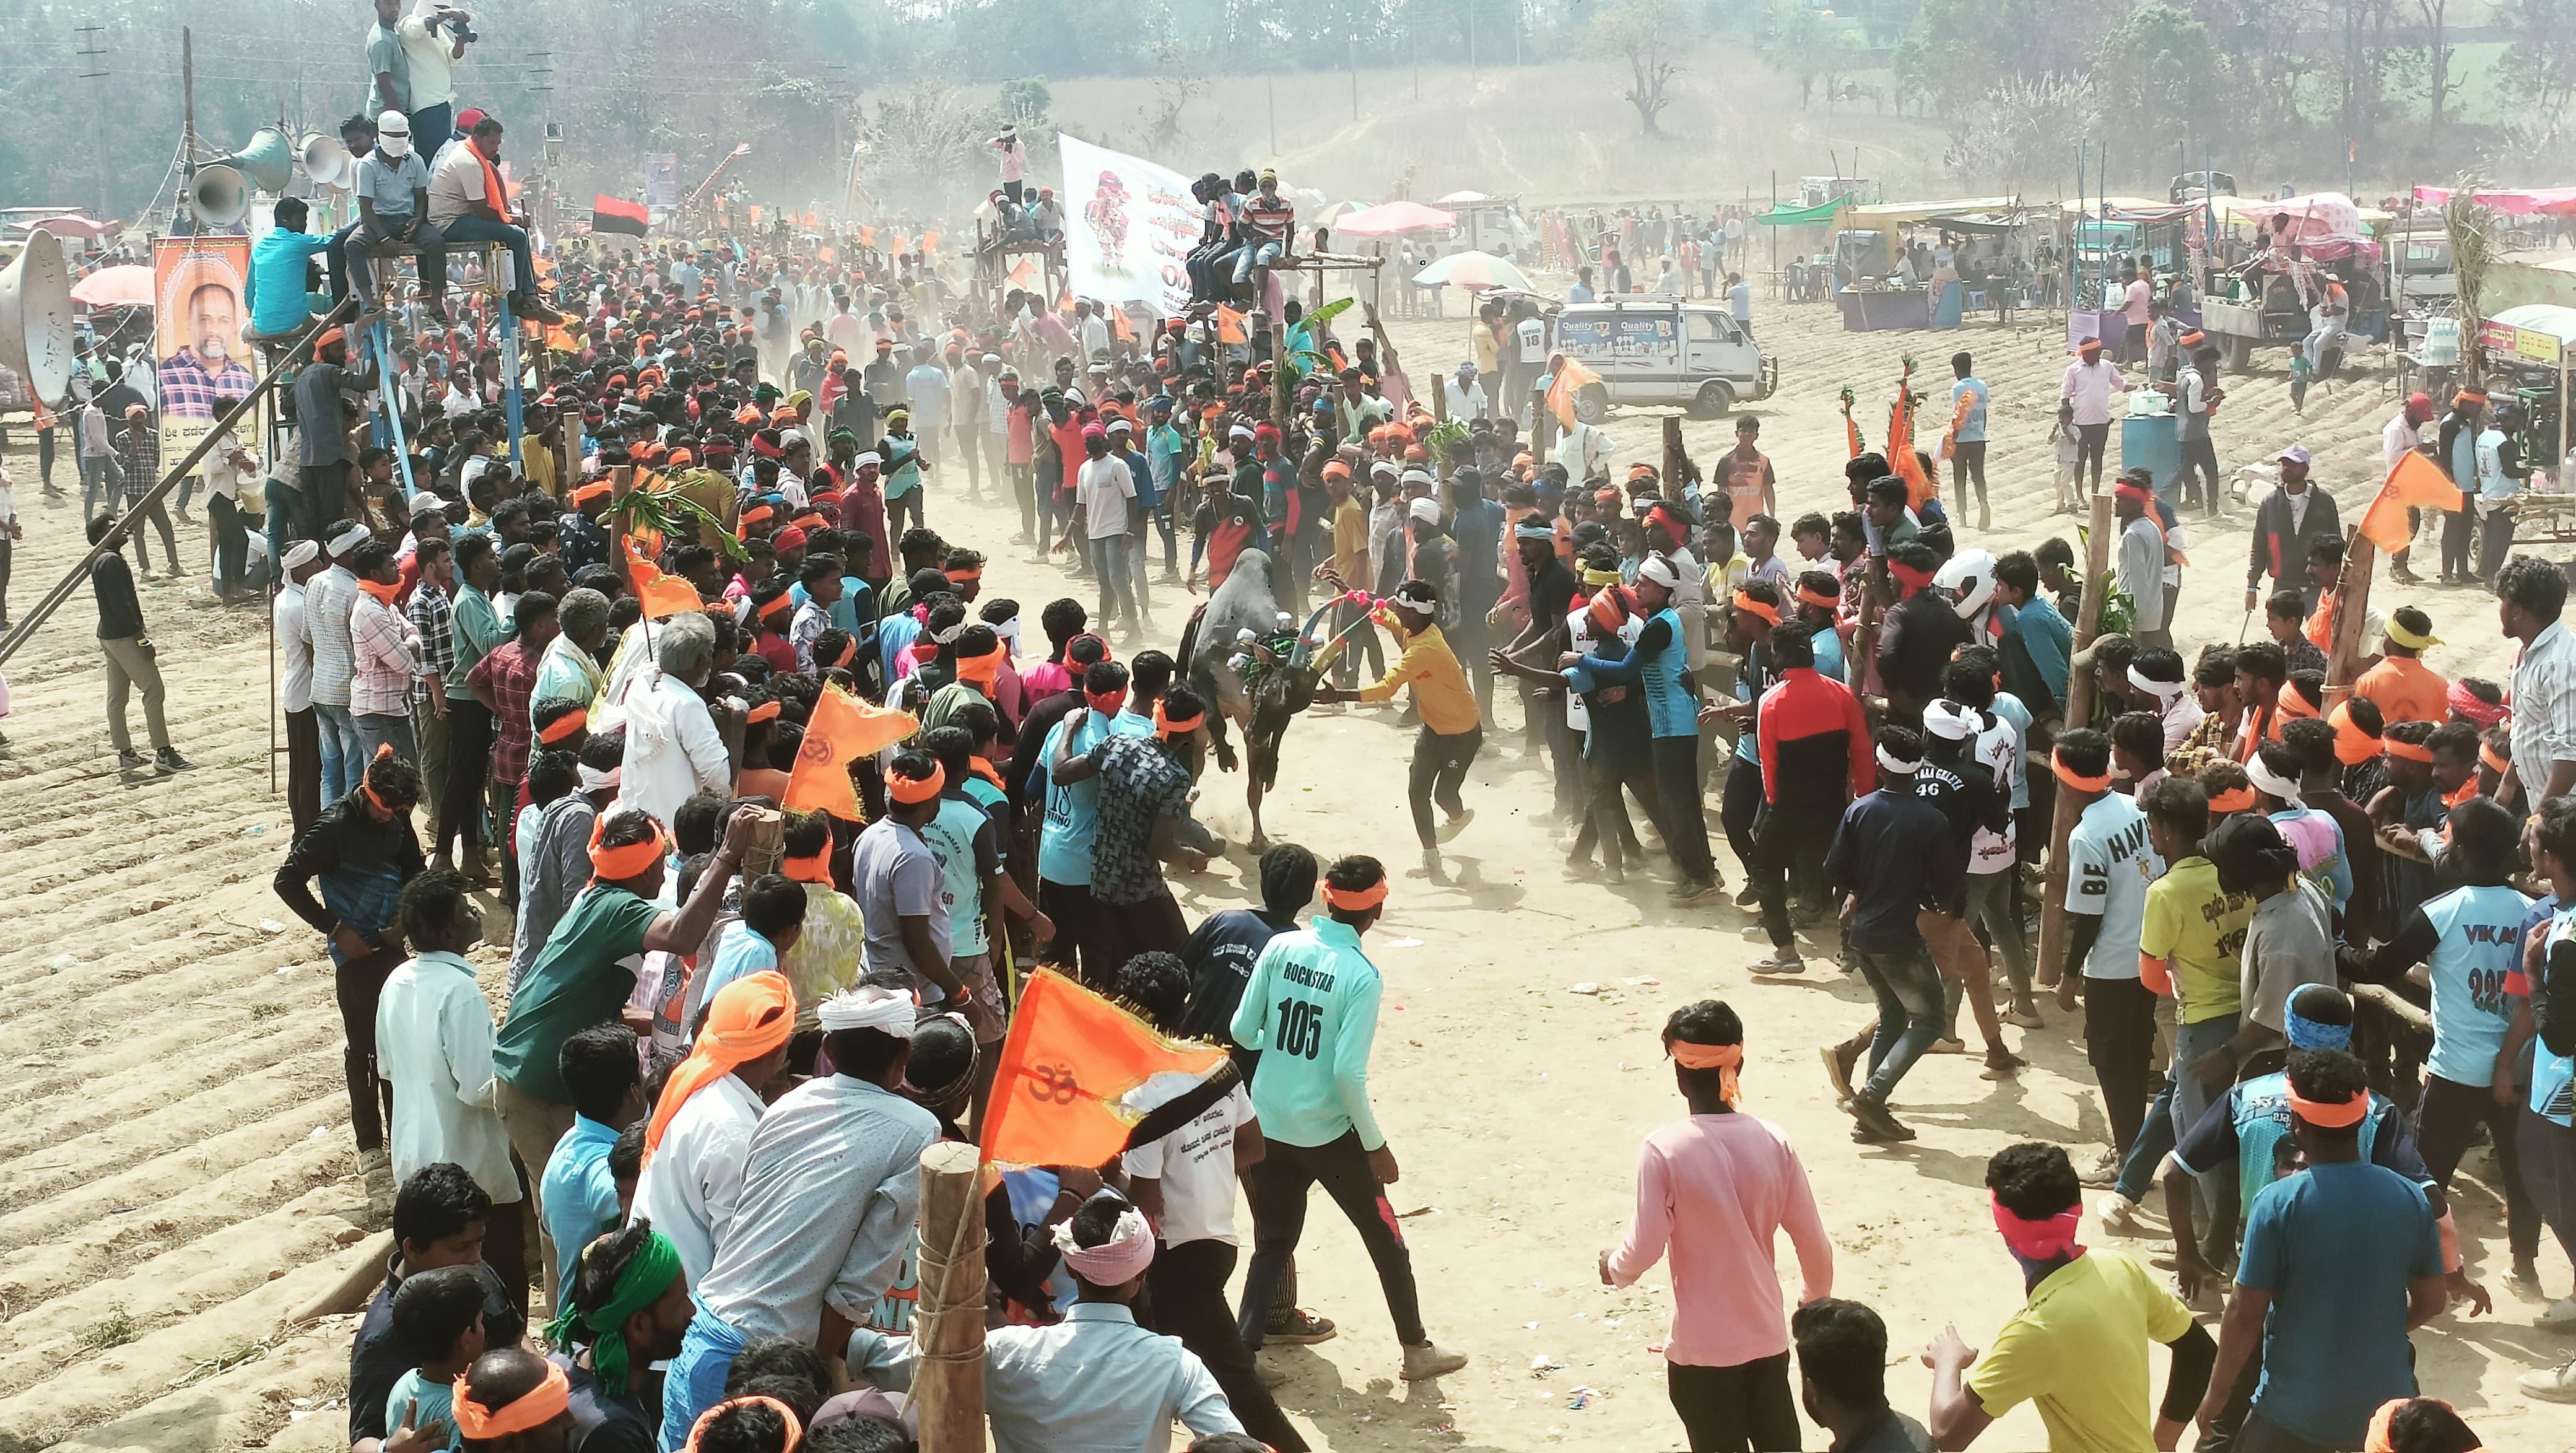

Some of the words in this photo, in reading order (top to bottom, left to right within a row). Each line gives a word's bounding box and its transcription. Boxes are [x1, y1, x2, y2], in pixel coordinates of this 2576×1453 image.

[1562, 321, 1593, 330] Quality
[1621, 321, 1654, 331] Quality
[1526, 335, 1539, 346] 18
[165, 427, 177, 441] ಶ್ರೀ
[1916, 783, 1939, 796] 46
[2107, 818, 2151, 863] HAV
[2081, 863, 2107, 895] BE
[1284, 962, 1335, 993] ROCKSTAR
[1276, 997, 1323, 1060] 105
